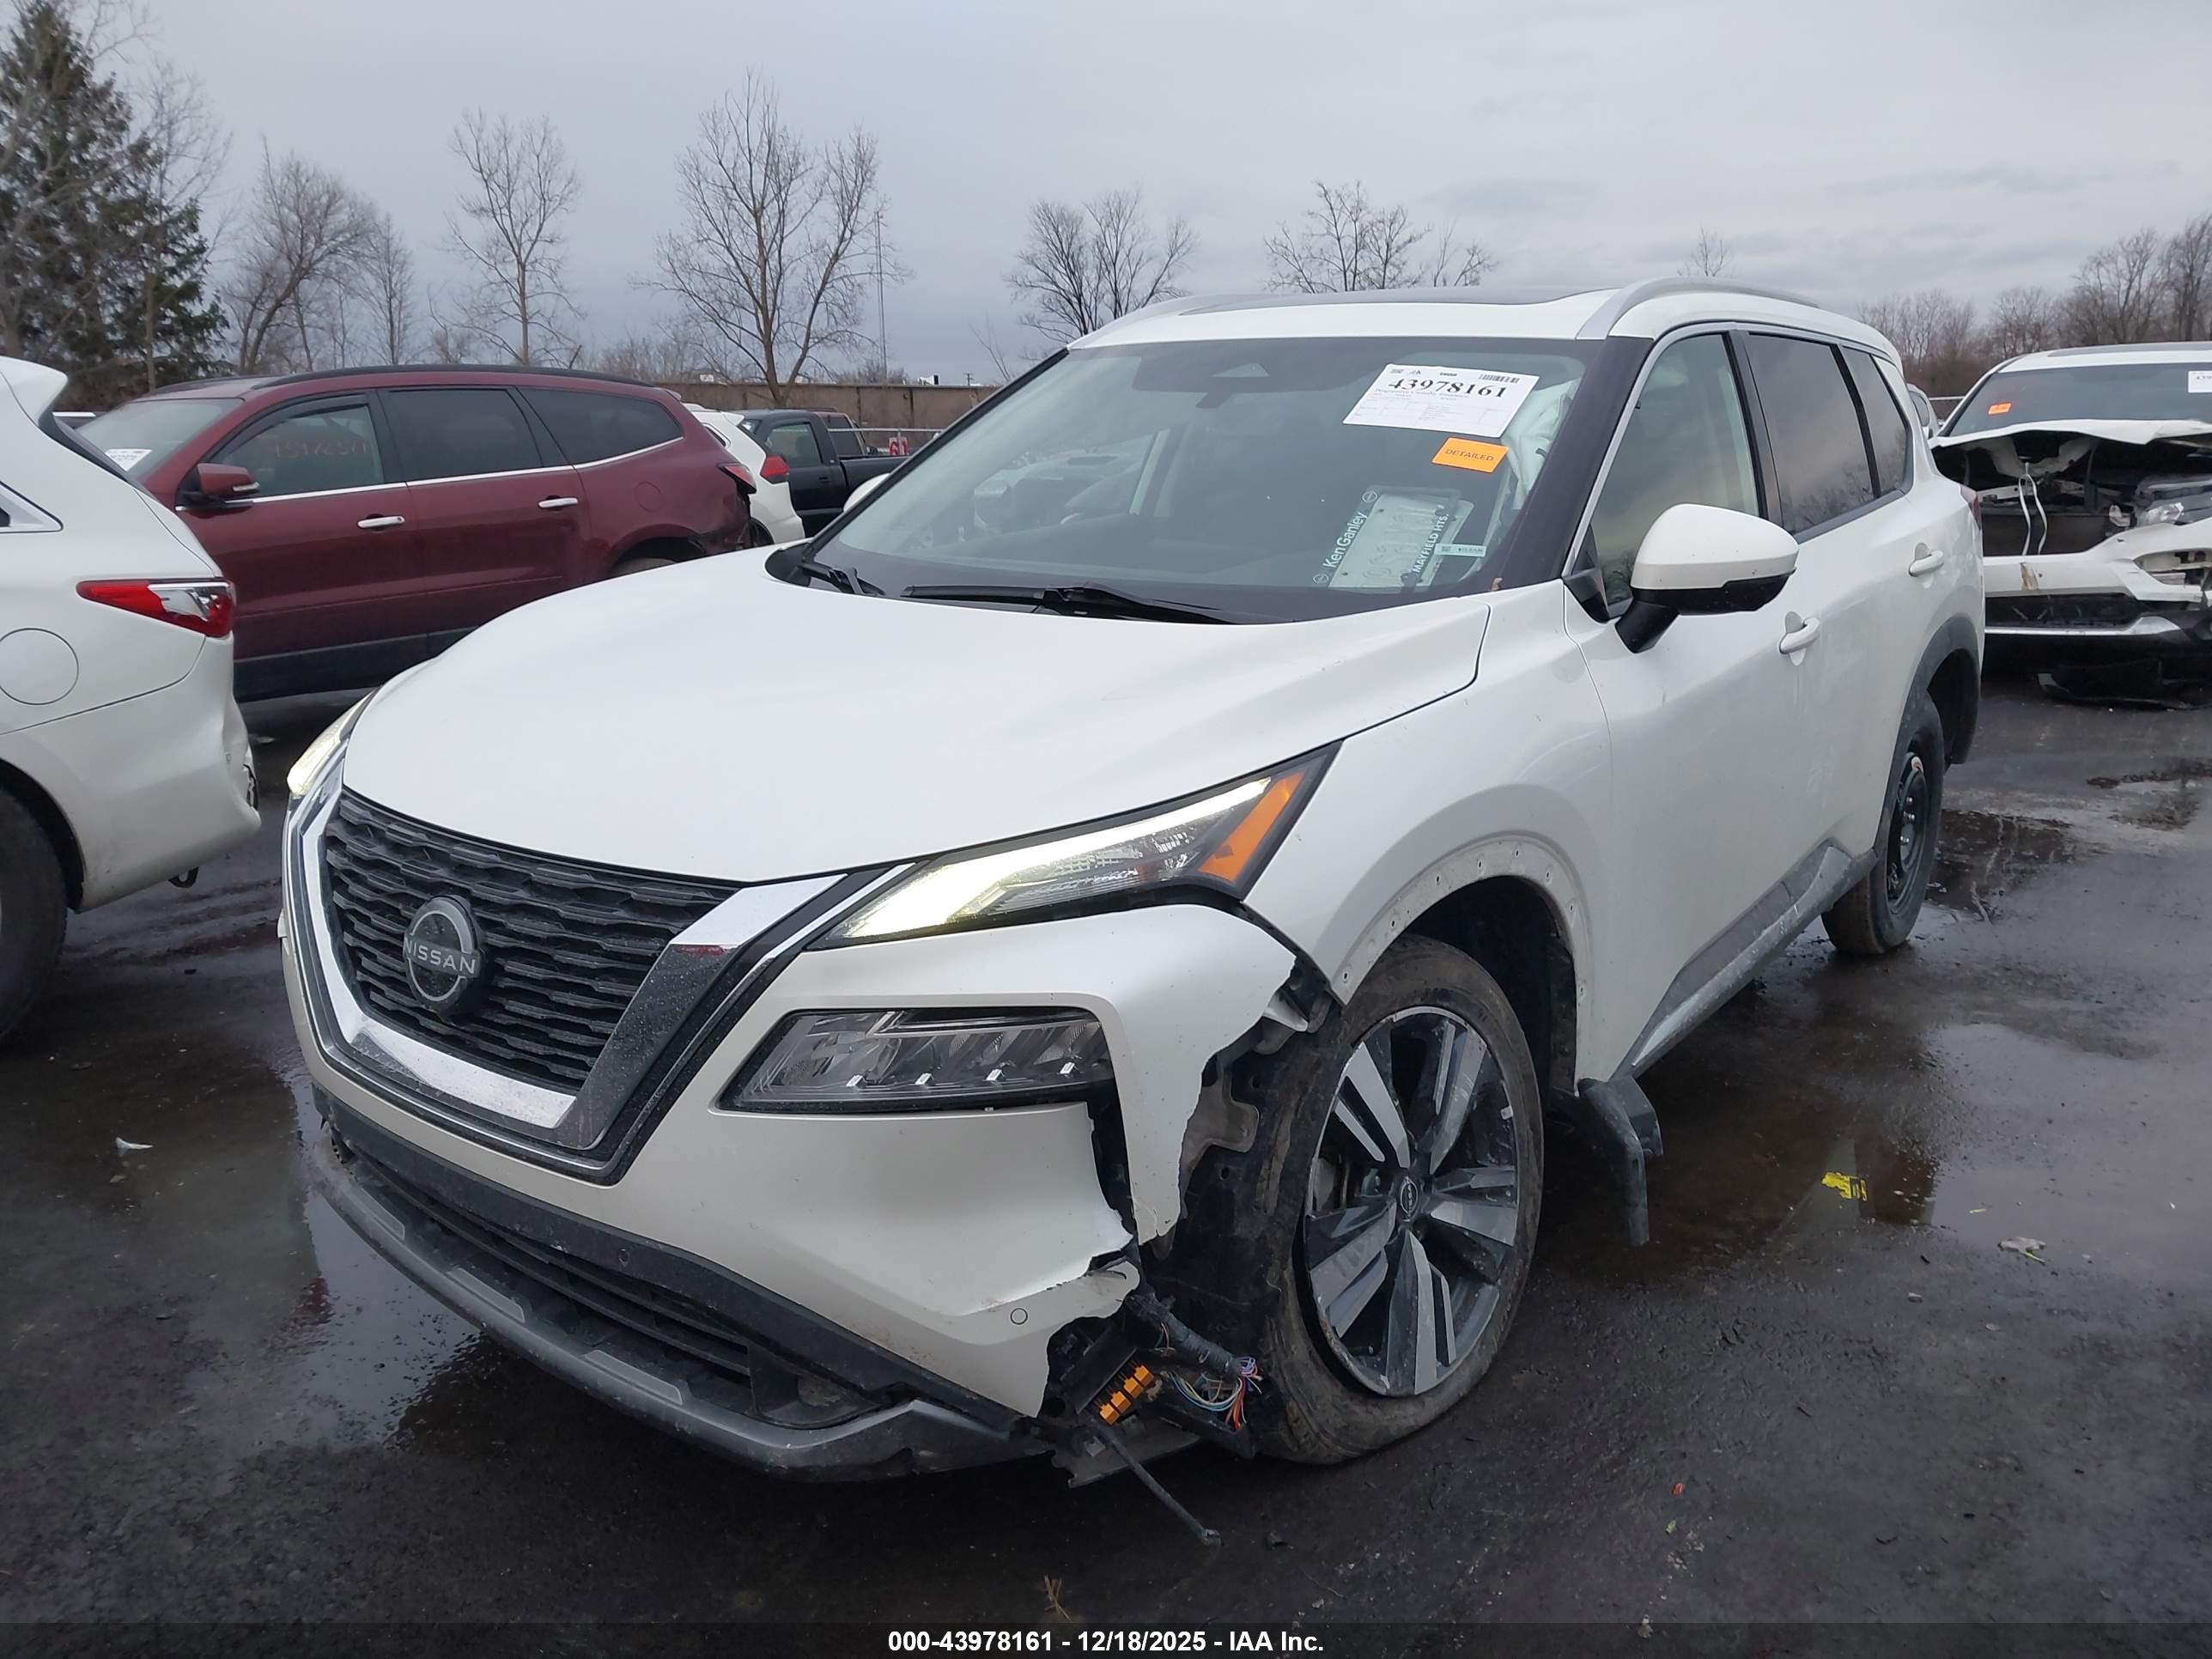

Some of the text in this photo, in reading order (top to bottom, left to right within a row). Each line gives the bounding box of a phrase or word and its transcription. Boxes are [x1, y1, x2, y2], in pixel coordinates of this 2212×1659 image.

[1389, 378, 1507, 398] 43978161
[1444, 448, 1494, 462] DETAILED
[1412, 532, 1440, 573] MAYFIELD
[404, 935, 476, 974] NISSAN
